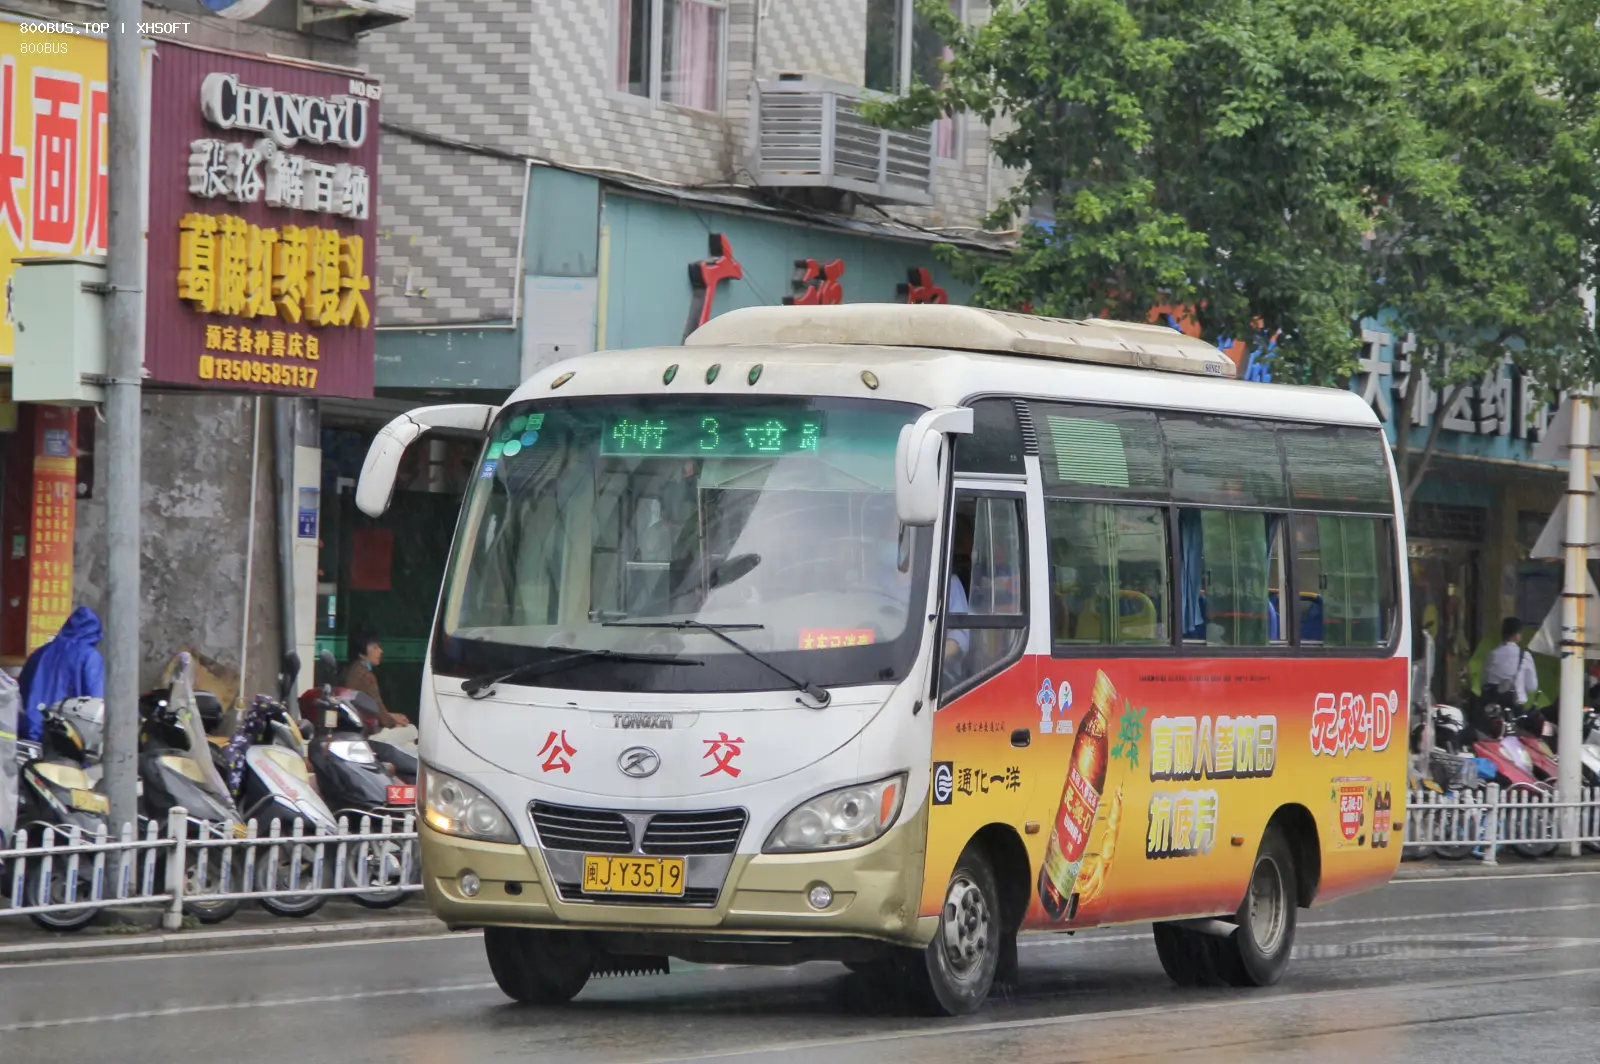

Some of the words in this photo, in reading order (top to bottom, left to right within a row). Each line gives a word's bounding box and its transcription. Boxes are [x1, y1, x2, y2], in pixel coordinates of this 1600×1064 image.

[202, 73, 369, 148] CHANGYU
[215, 358, 318, 389] 13509585137
[700, 418, 720, 450] 3
[613, 713, 674, 730] TONGXIN
[537, 730, 577, 774] 公
[700, 732, 746, 778] 交
[1151, 717, 1276, 780] 高丽人参饮品
[957, 766, 1021, 797] 通化一洋
[1147, 790, 1218, 857] 抗疲劳
